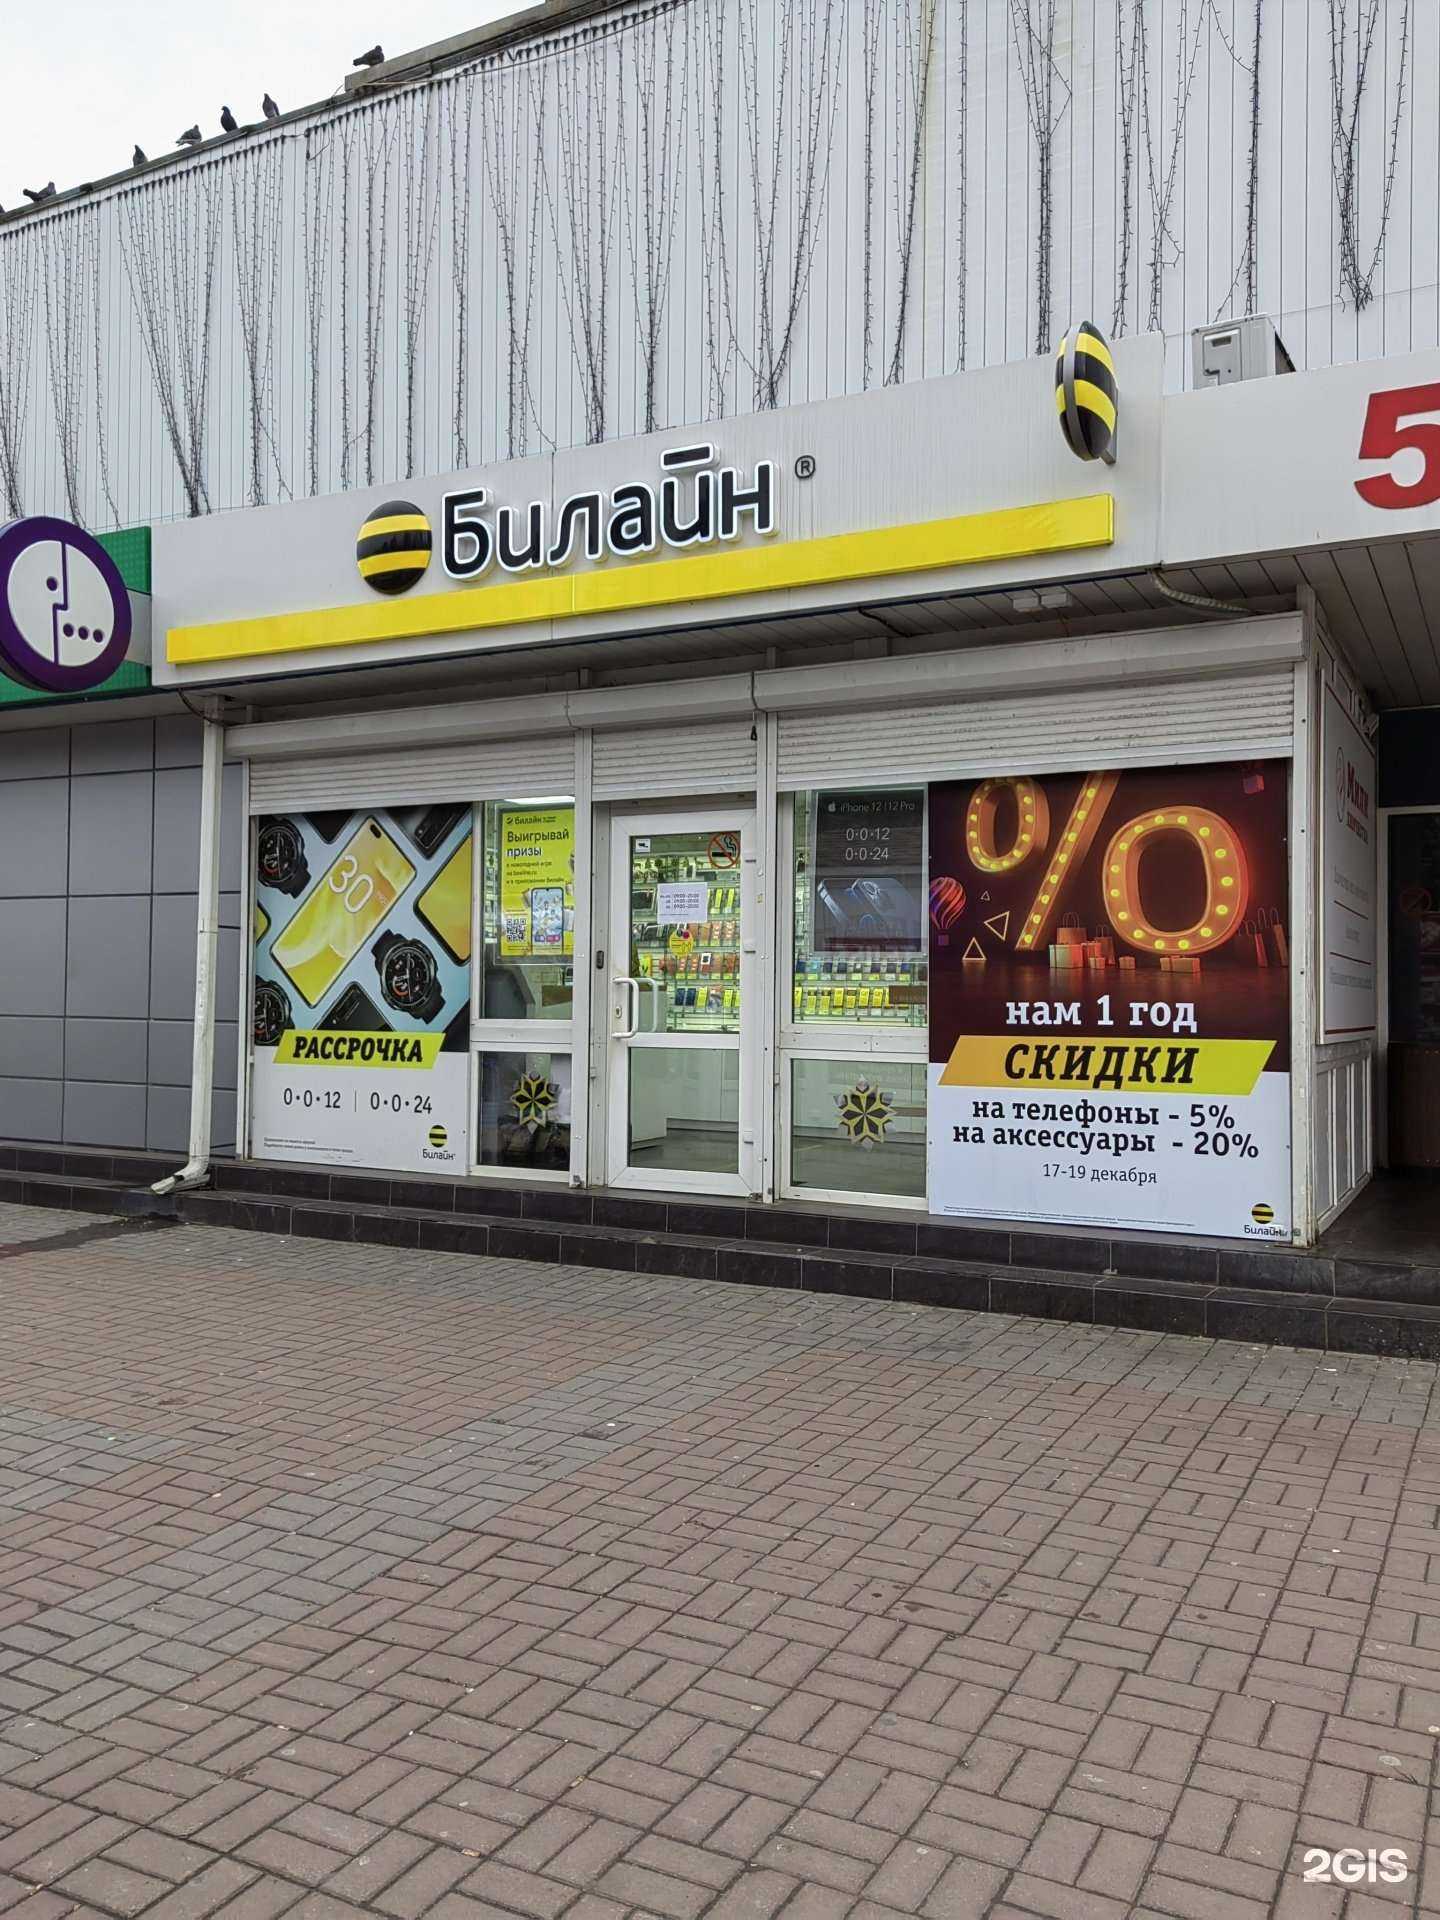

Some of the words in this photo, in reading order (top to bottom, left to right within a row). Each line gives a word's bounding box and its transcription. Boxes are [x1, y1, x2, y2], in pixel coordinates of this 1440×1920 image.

[1354, 382, 1440, 510] 5
[442, 442, 775, 580] Билайн
[840, 800, 868, 813] iPhone
[871, 800, 882, 812] 12
[888, 800, 898, 811] 12
[900, 801, 915, 811] Pro
[507, 828, 570, 843] Выигрывай
[507, 847, 542, 860] призы
[1005, 1000, 1082, 1026] нам
[1096, 994, 1114, 1026] 1
[1128, 1001, 1198, 1033] год
[292, 1036, 423, 1063] РАССРОЧКА
[1004, 1043, 1200, 1090] СКИДКИ
[972, 1100, 1005, 1119] на
[1012, 1099, 1159, 1128] телефоны
[422, 1148, 453, 1161] Билайн
[952, 1124, 986, 1144] на
[992, 1127, 1156, 1157] аксессуары
[1042, 1163, 1087, 1180] 17-19
[1090, 1165, 1158, 1186] декабря
